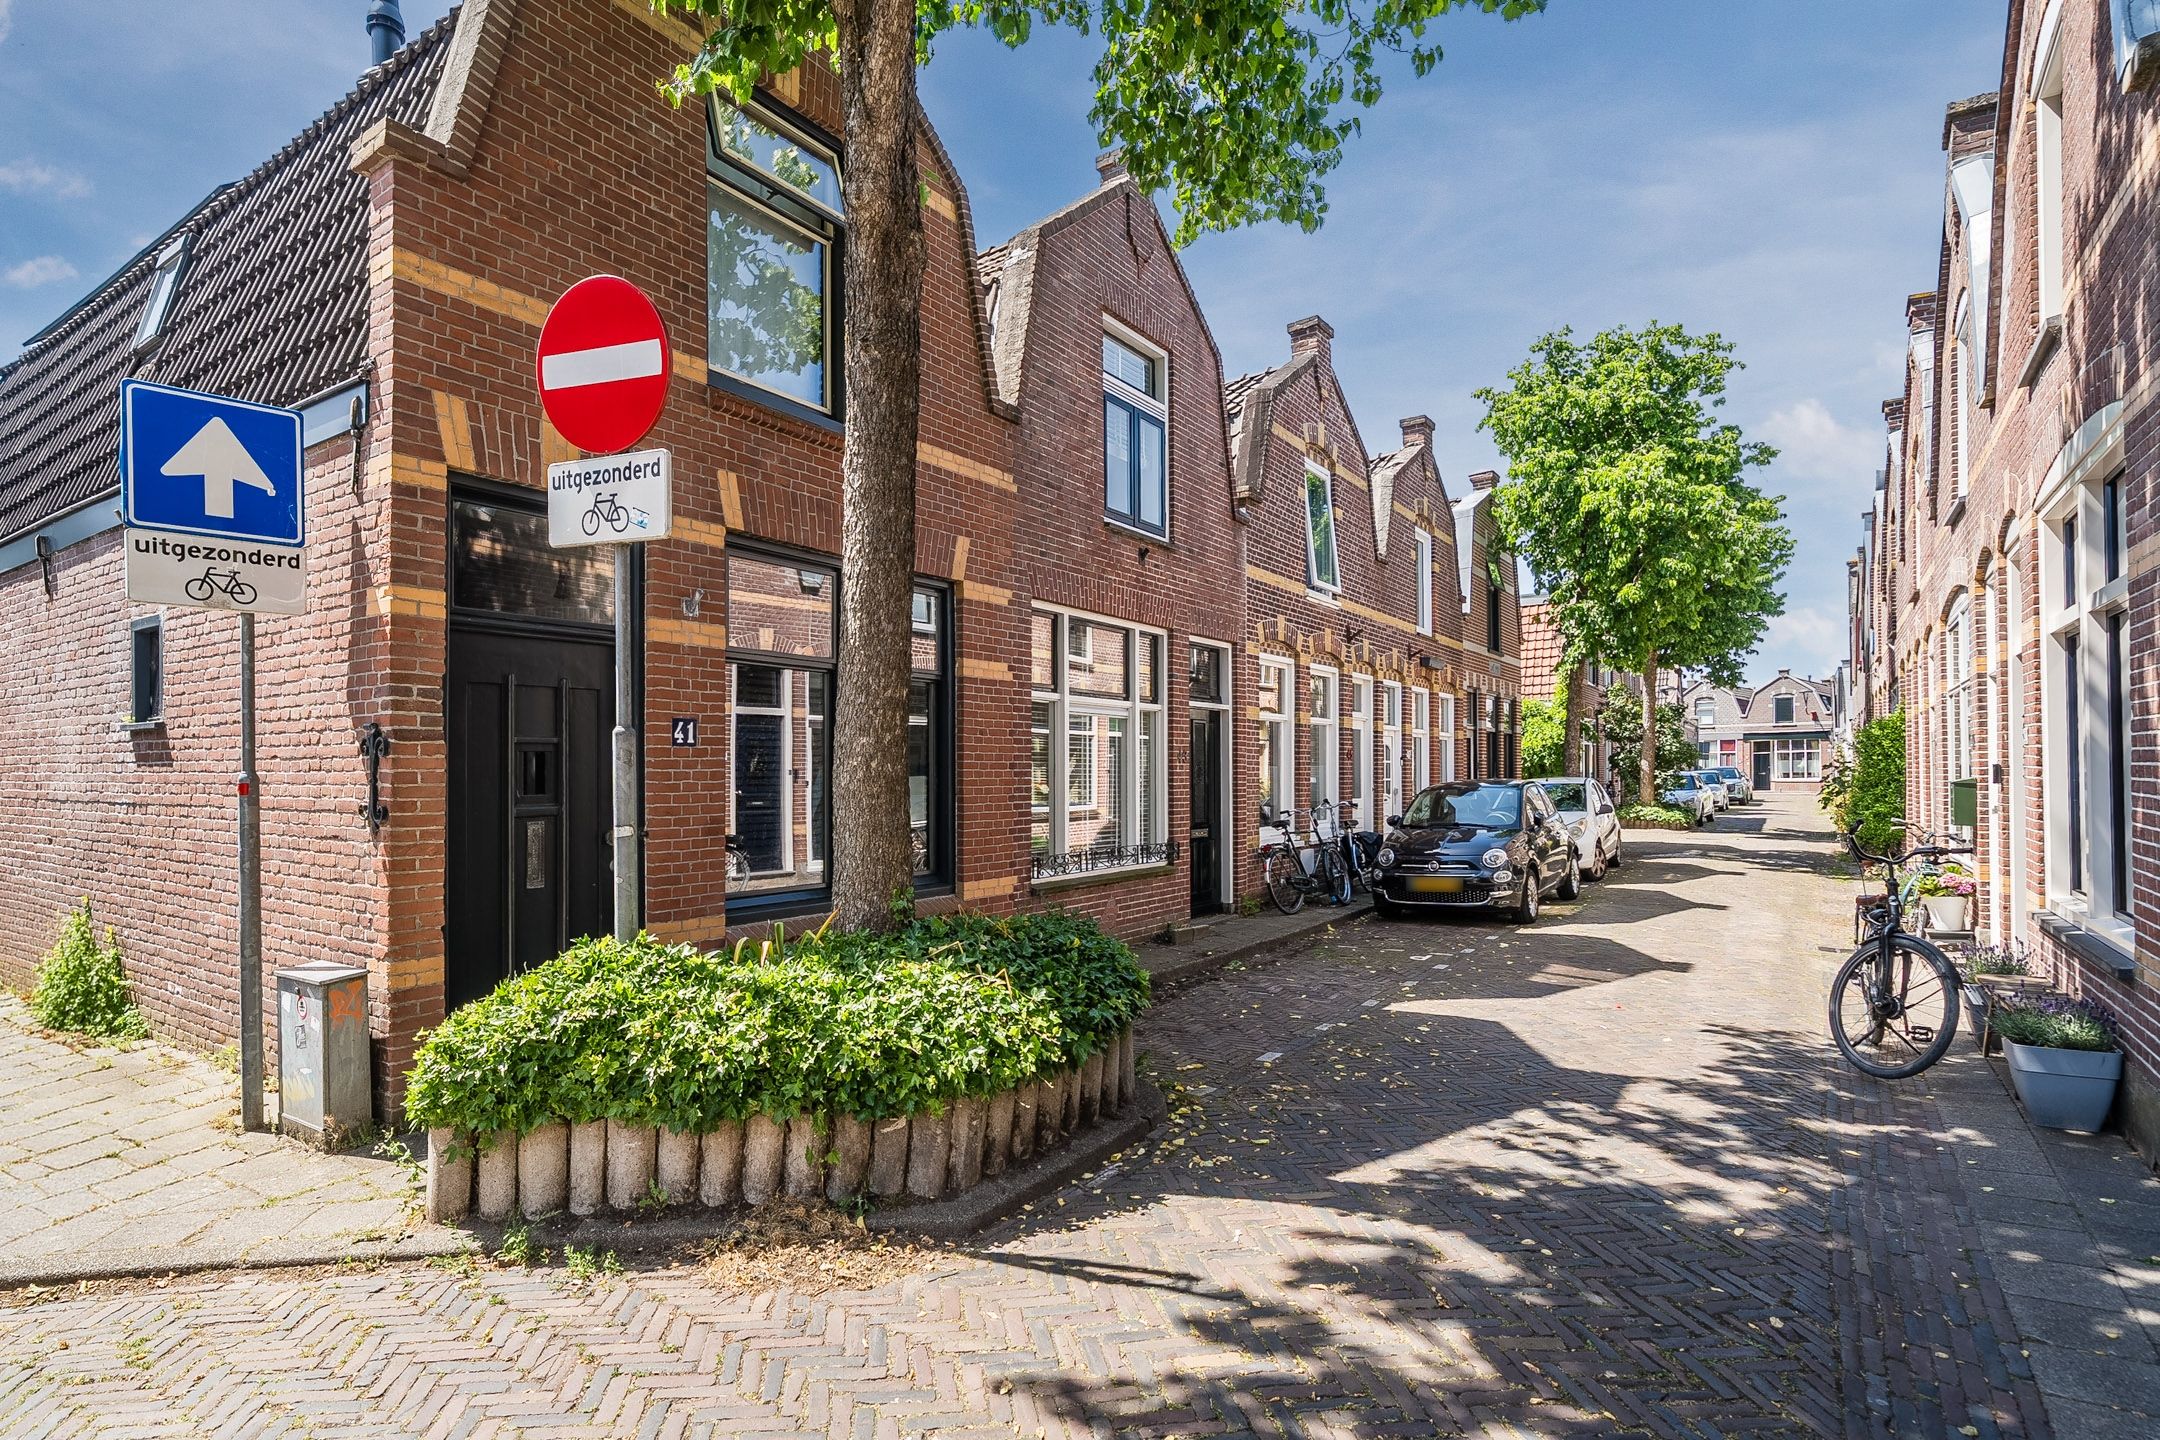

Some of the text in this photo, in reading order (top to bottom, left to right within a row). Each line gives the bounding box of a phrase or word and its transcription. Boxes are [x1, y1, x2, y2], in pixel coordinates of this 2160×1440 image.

[552, 457, 661, 494] uitgezonderd
[134, 537, 300, 569] uitgezonderd
[674, 721, 695, 744] 41
